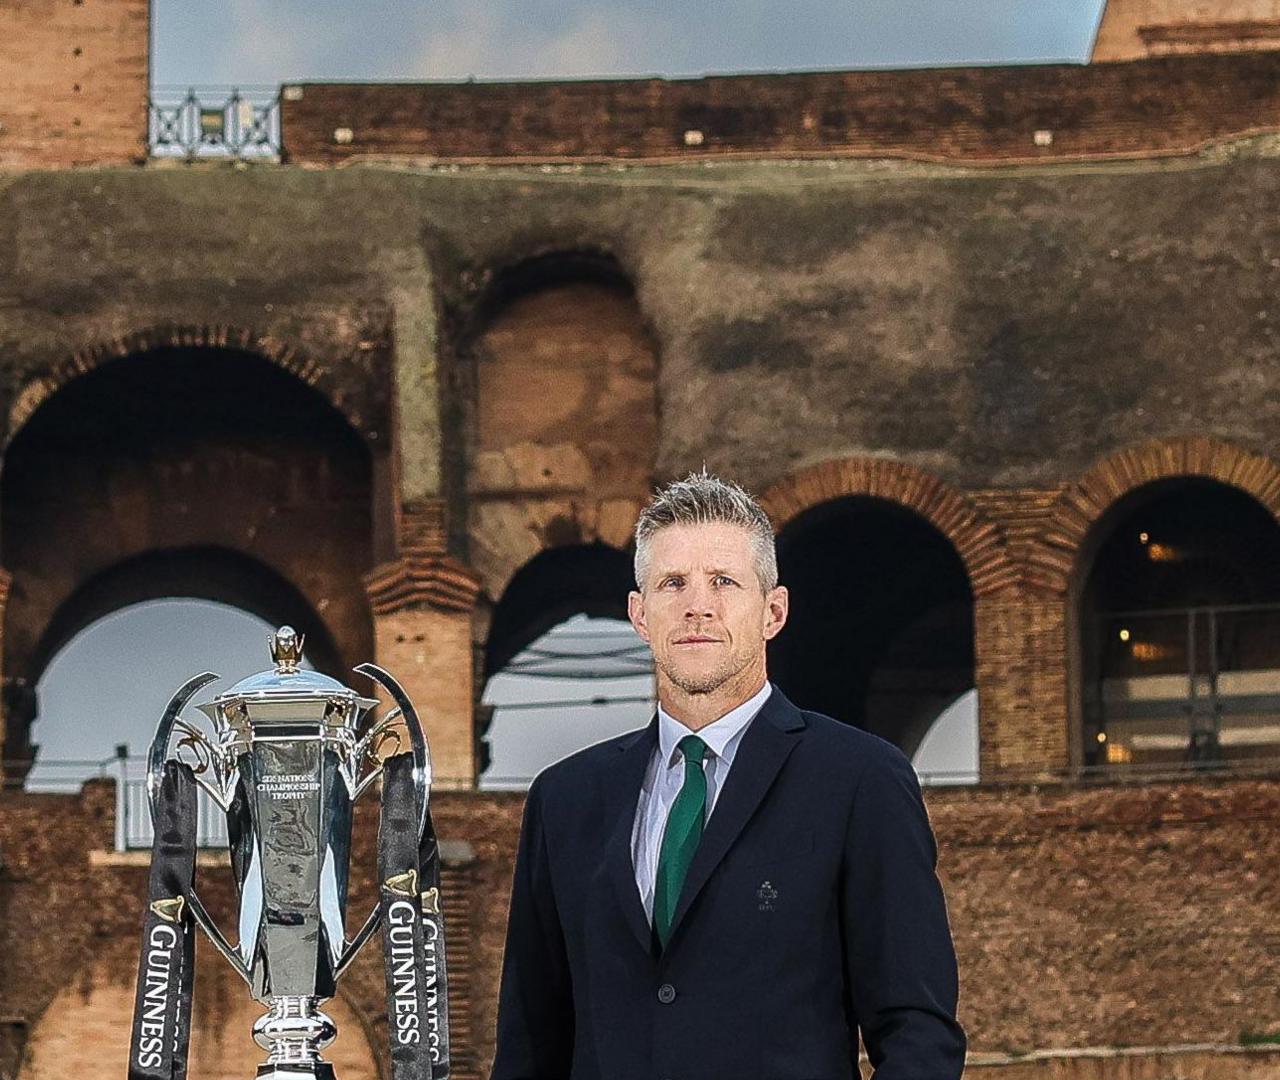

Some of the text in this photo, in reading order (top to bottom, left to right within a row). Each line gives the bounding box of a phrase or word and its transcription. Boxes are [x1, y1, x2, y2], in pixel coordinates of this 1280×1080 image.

[277, 774, 316, 783] NATIONS
[256, 783, 321, 791] CHAMPIONSHIP
[271, 791, 306, 800] TROPHY
[388, 900, 421, 1045] GUINNESS
[138, 924, 177, 1068] GUINNESS
